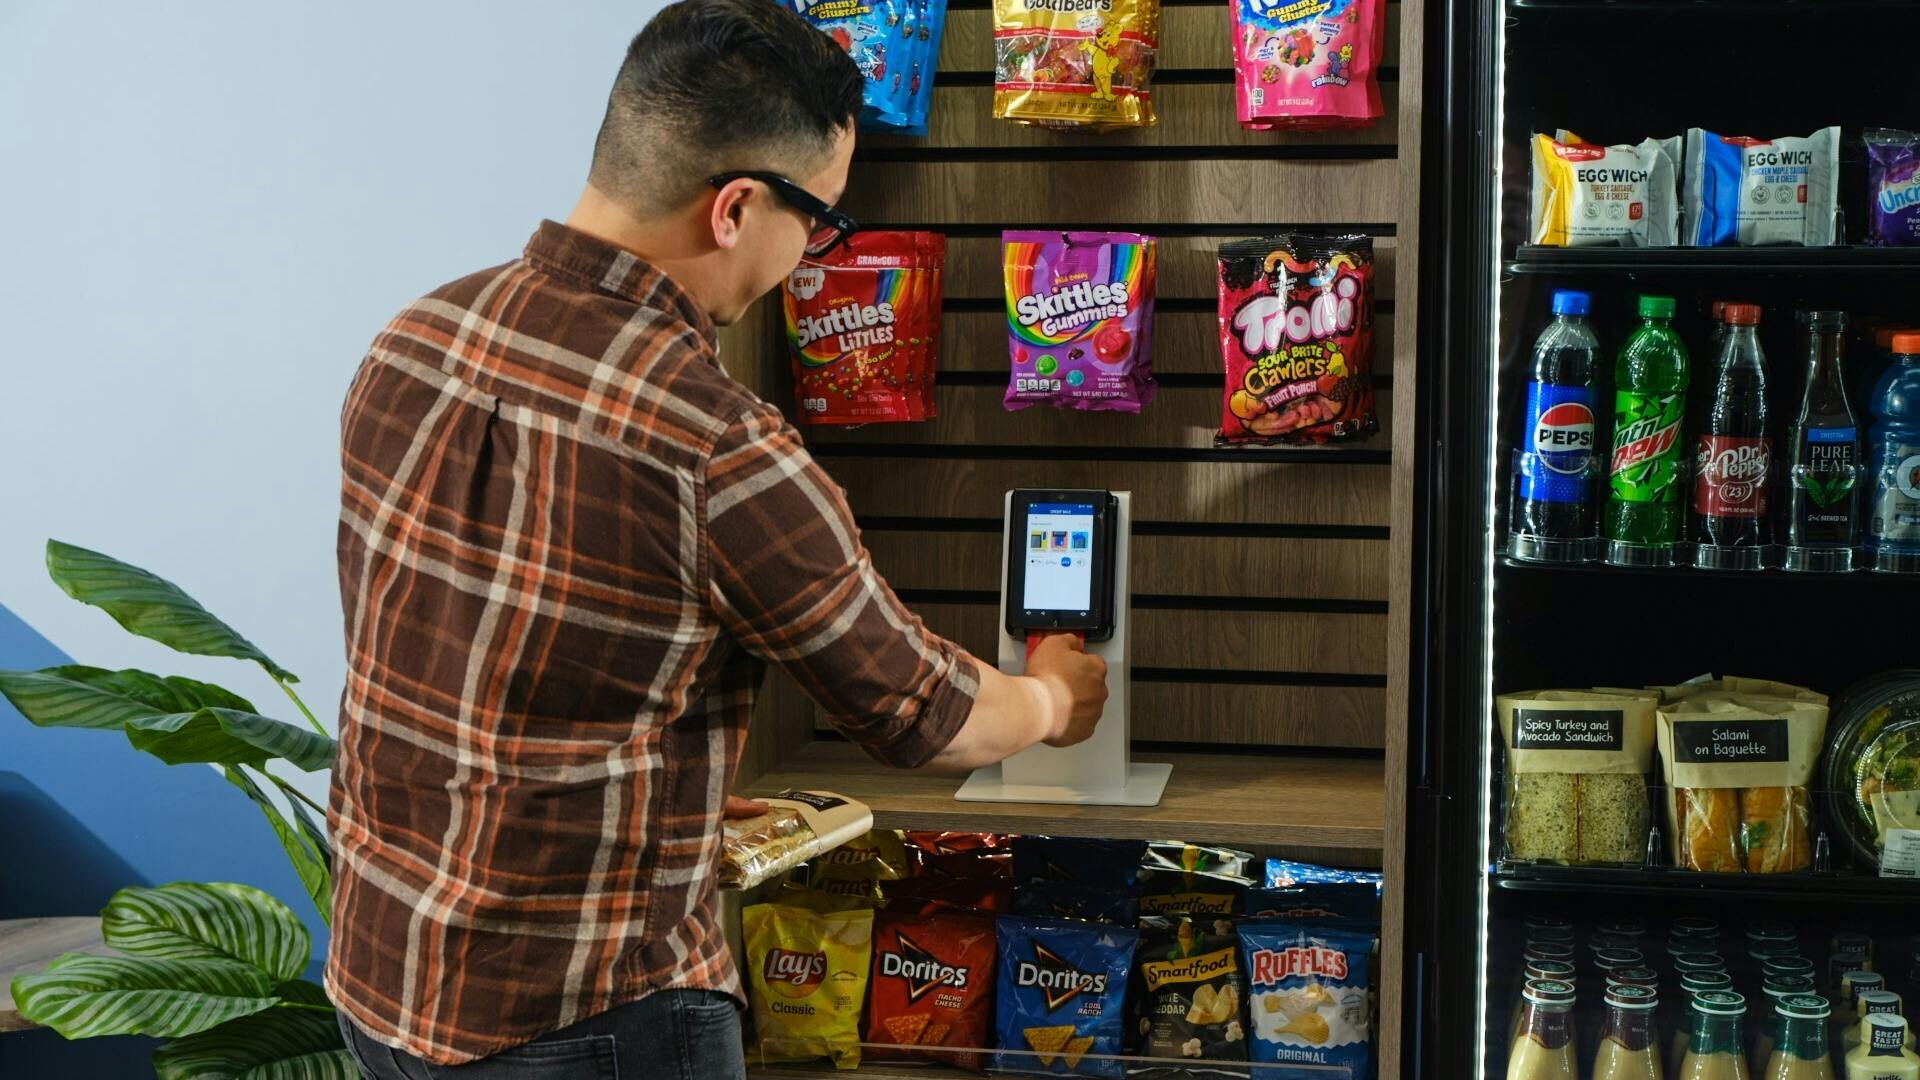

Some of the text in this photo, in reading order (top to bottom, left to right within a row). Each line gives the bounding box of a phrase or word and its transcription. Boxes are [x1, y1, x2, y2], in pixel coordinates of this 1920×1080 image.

[1267, 0, 1318, 18] Gummy
[1311, 74, 1348, 88] rainbow
[1748, 151, 1812, 167] EGG WICH
[1018, 281, 1129, 325] Skittles
[1041, 304, 1128, 336] Gummies
[1234, 277, 1358, 355] Trolli
[797, 302, 895, 348] Skittles
[1258, 350, 1288, 370] SOUR
[1245, 358, 1327, 395] Crawlers
[1265, 380, 1317, 408] FRUIT PUNCH
[1539, 429, 1594, 446] PEPSI
[1738, 446, 1759, 462] Dr
[1811, 446, 1850, 458] PURE
[1717, 449, 1767, 479] Pepper
[1811, 459, 1850, 472] LEAF
[1728, 487, 1742, 497] 23
[1525, 718, 1609, 732] Spicy Turkey and
[1520, 731, 1614, 742] Avocado Sandwich
[1711, 728, 1750, 741] Salami
[1695, 742, 1767, 758] on Baguette
[767, 950, 824, 985] Lay's
[883, 952, 969, 987] Doritos
[1148, 954, 1229, 984] Smartfood
[1252, 947, 1348, 986] RUFFLES
[1018, 962, 1107, 993] Doritos
[934, 1000, 962, 1009] CHEESE
[937, 993, 962, 1002] NACHO
[771, 1001, 816, 1016] Classic
[1077, 1008, 1102, 1016] RANCH
[1869, 1005, 1896, 1013] GREAT
[1875, 1030, 1902, 1038] GREAT
[1875, 1036, 1901, 1044] TASTE
[1276, 1049, 1328, 1064] ORIGINAL
